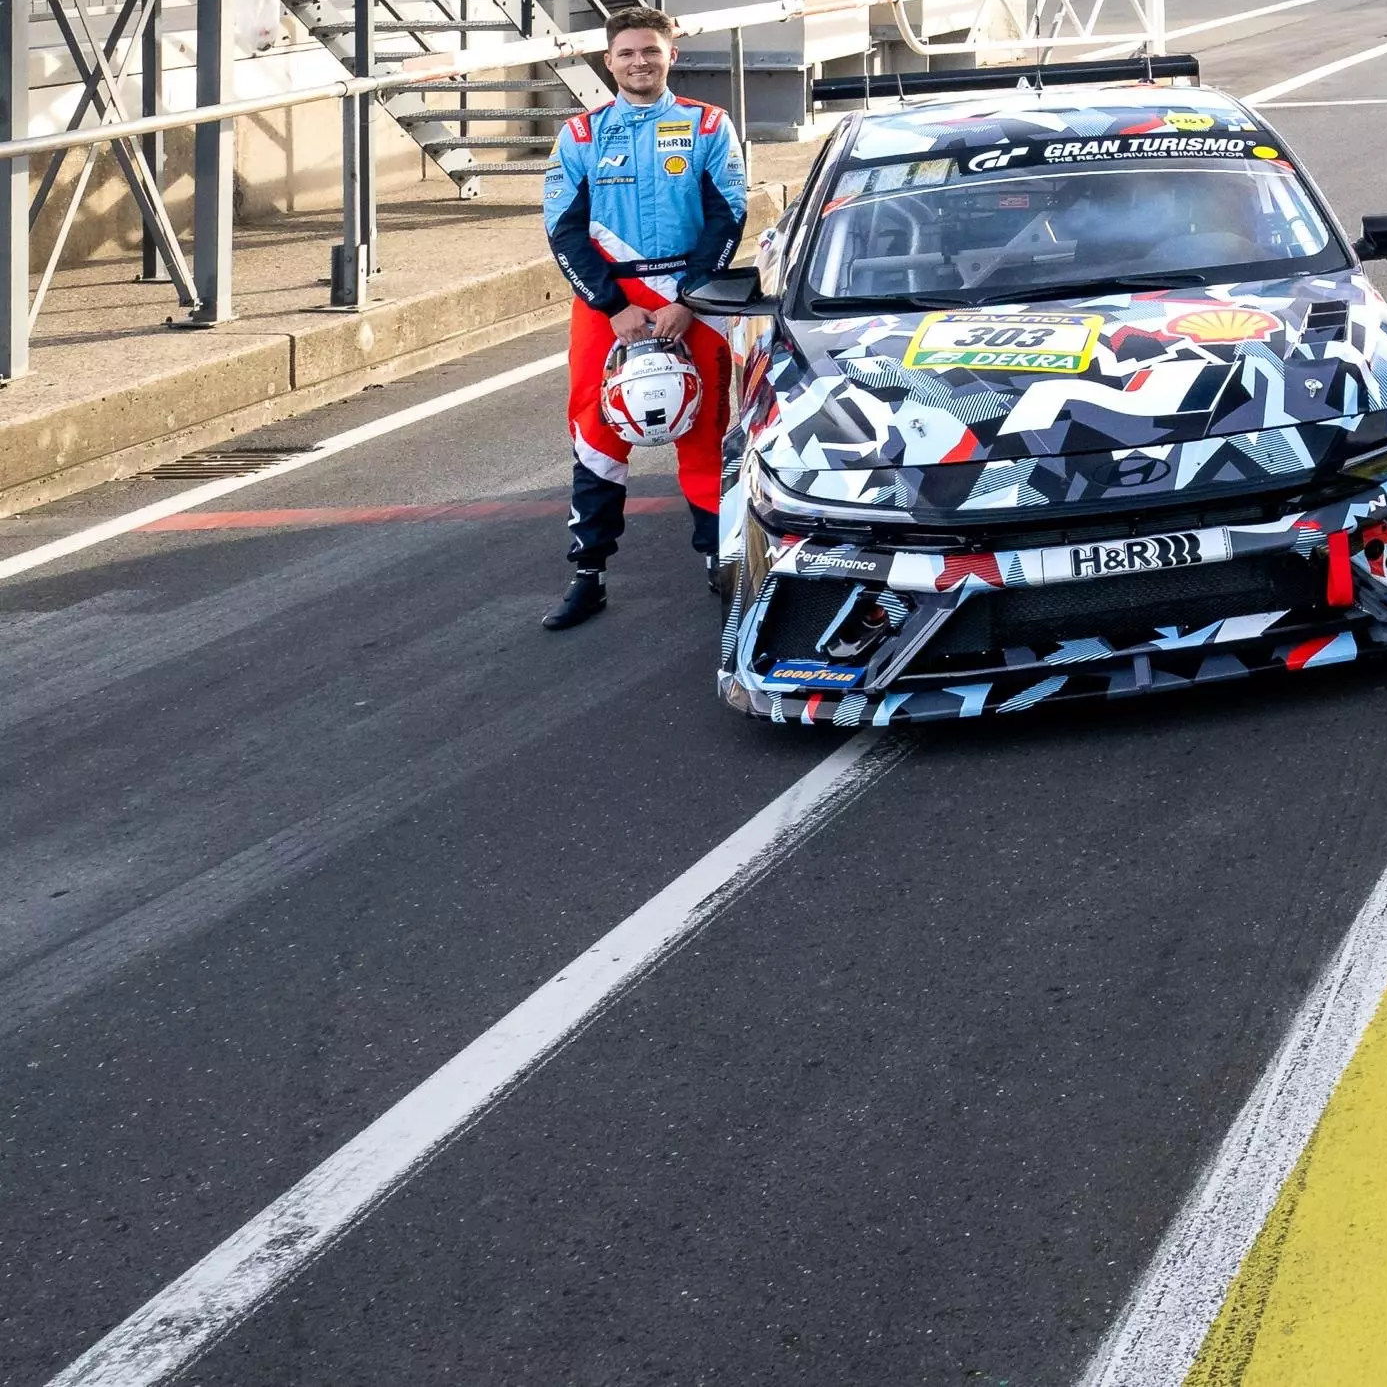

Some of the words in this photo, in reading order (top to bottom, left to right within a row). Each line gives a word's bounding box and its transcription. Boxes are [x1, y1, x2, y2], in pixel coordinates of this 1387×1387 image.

[657, 139, 680, 149] H&R
[1044, 140, 1120, 158] GRAN
[1046, 155, 1074, 164] THE
[1076, 153, 1113, 162] REAL
[1115, 151, 1167, 159] DRIVING
[1170, 150, 1245, 159] SIMULATOR
[544, 173, 564, 183] OTON
[566, 266, 596, 302] HYUNDAI
[949, 314, 1078, 325] RAVENOL
[953, 326, 1057, 349] 303
[969, 351, 1078, 370] DEKRA
[796, 549, 877, 572] Performance
[1070, 540, 1152, 579] H&R
[771, 667, 856, 684] GOODYEAR
